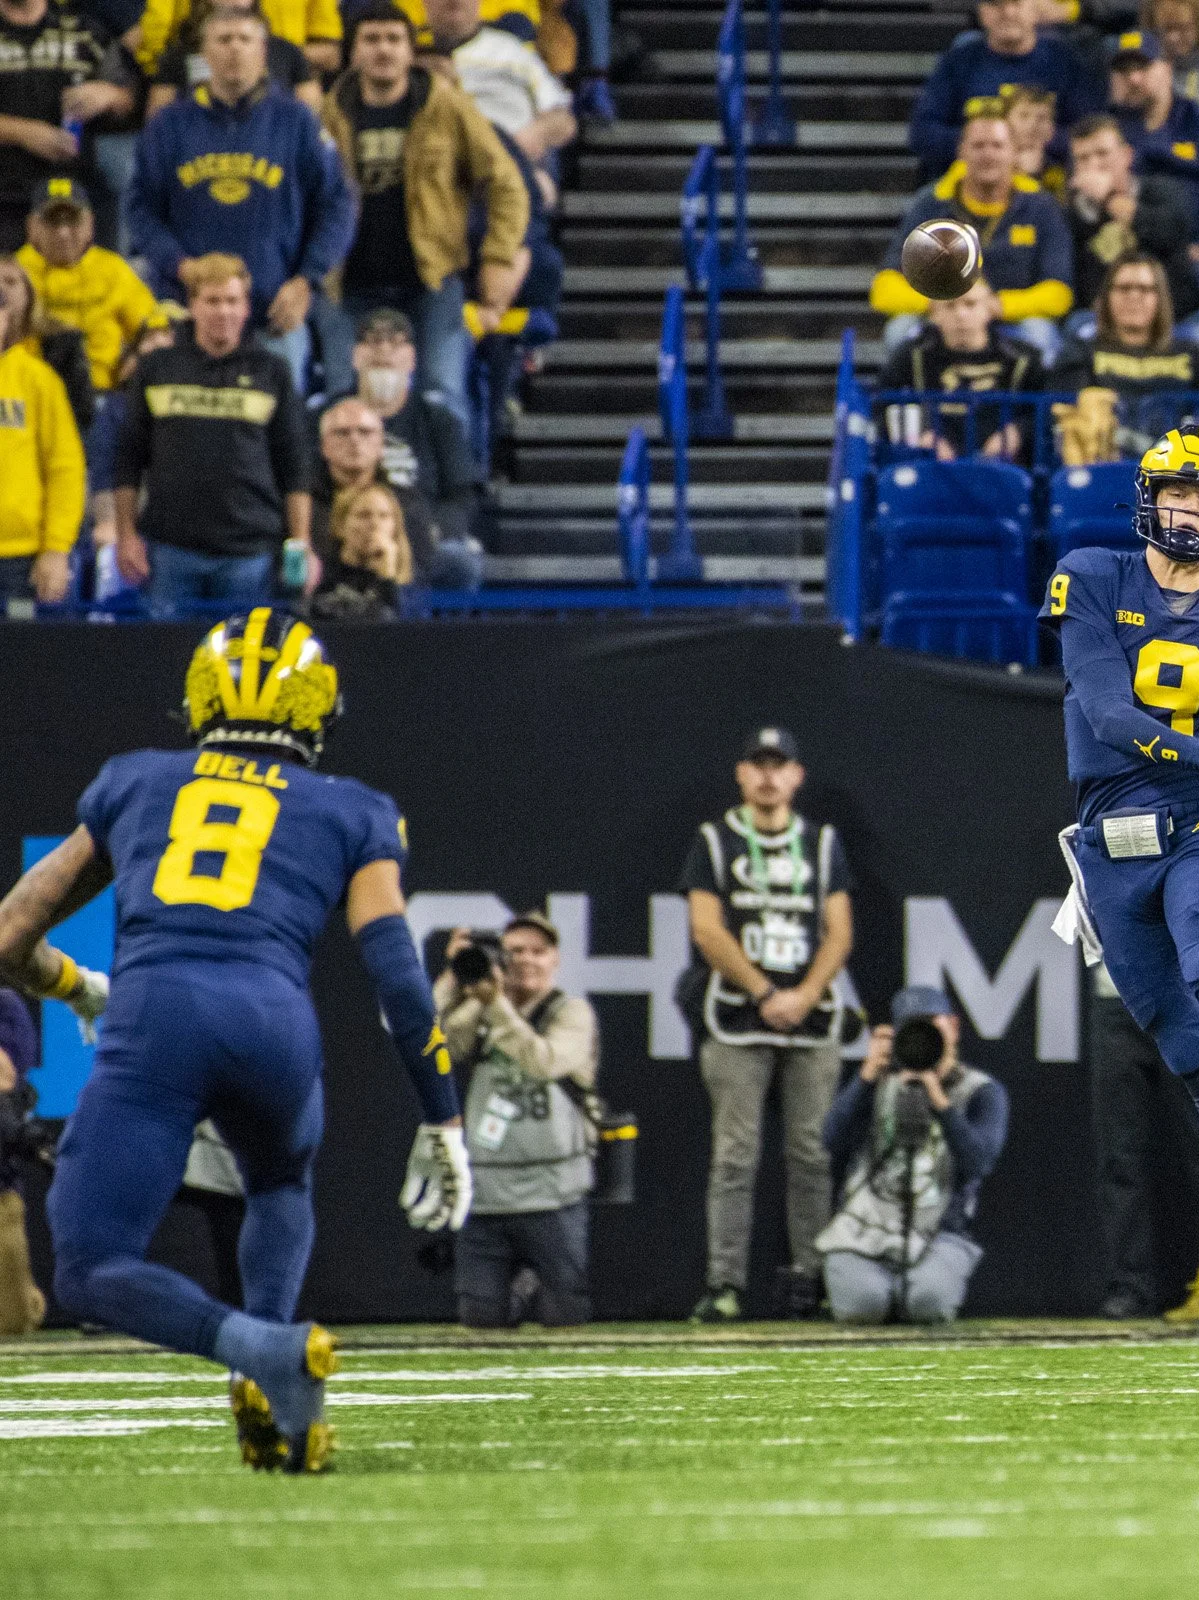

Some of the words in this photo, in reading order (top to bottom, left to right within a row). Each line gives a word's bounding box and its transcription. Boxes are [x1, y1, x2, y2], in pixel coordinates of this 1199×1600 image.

[178, 153, 284, 190] MICHIGAN
[1050, 574, 1070, 616] 9
[194, 751, 288, 789] BELL
[152, 777, 280, 912] 8
